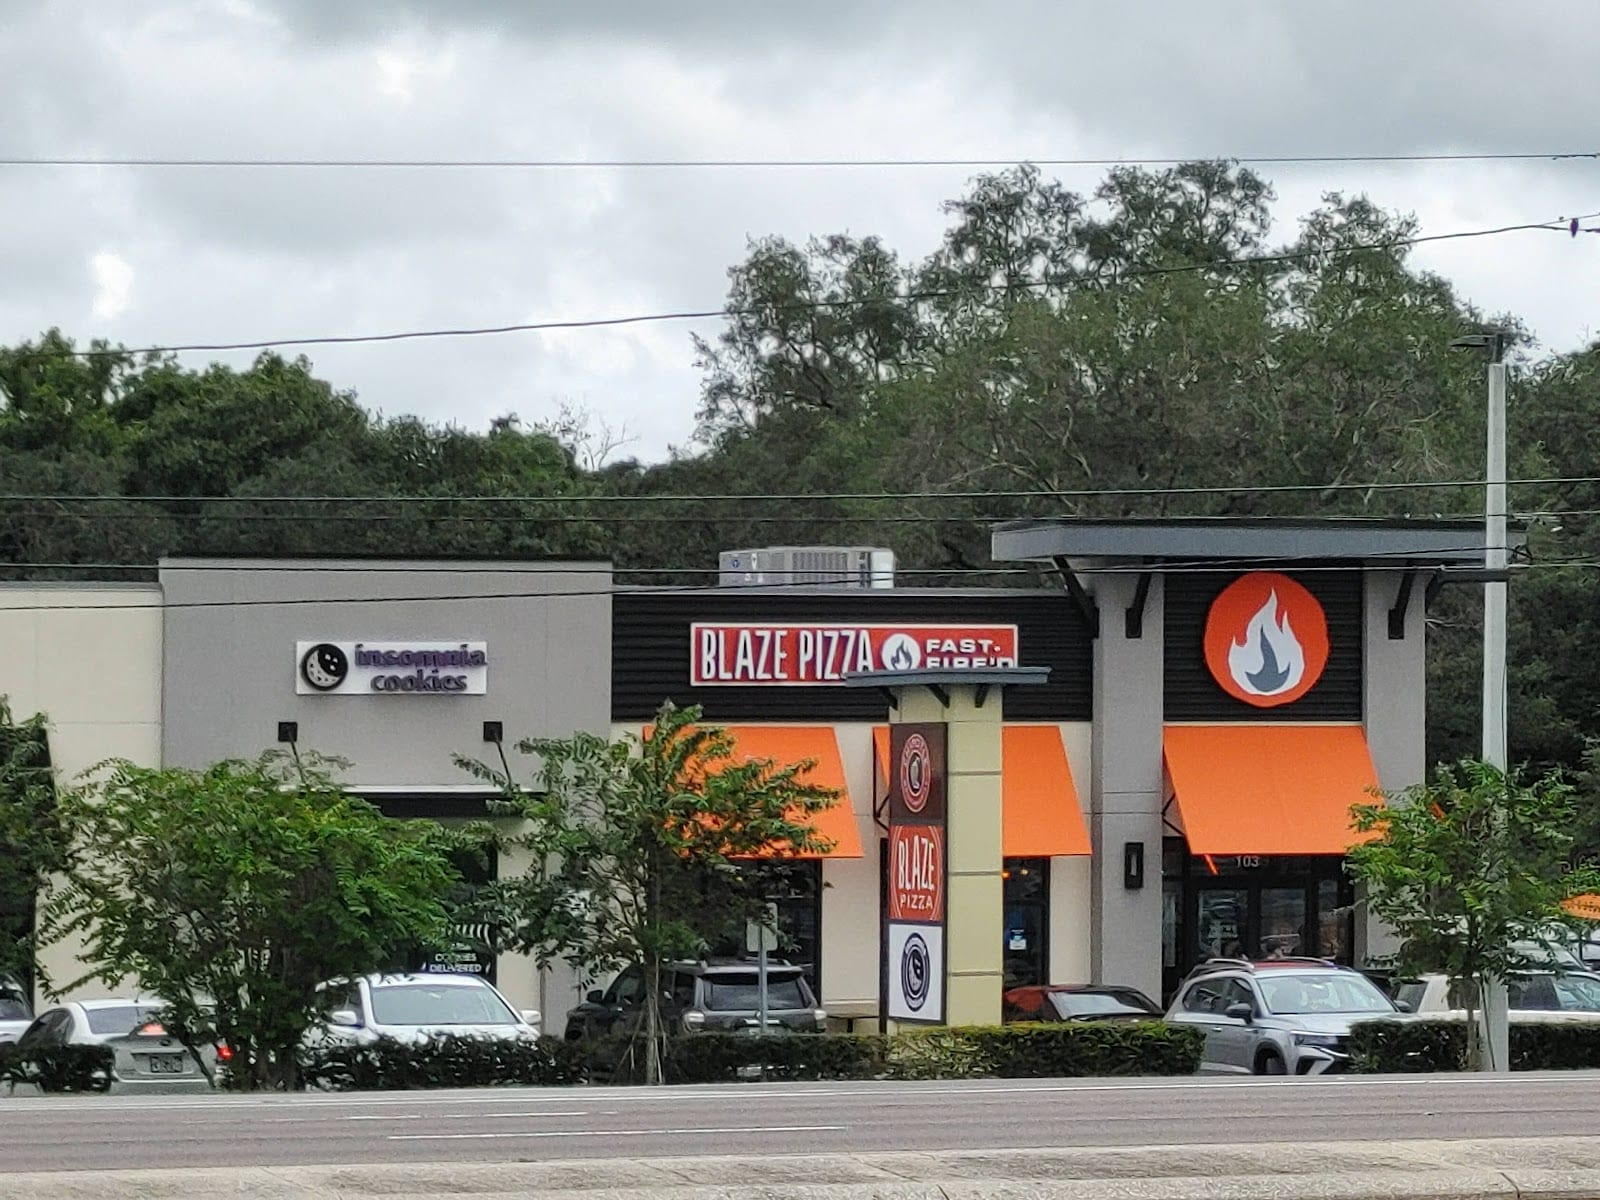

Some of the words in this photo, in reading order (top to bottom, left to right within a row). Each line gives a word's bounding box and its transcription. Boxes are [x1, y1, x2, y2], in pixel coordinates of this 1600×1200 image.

[355, 643, 487, 668] insomnia
[701, 629, 788, 680] BLAZE
[799, 629, 874, 680] PIZZA
[371, 669, 467, 692] cookies
[898, 834, 935, 891] BLAZE
[1234, 855, 1260, 869] 103
[900, 893, 934, 910] PIZZA
